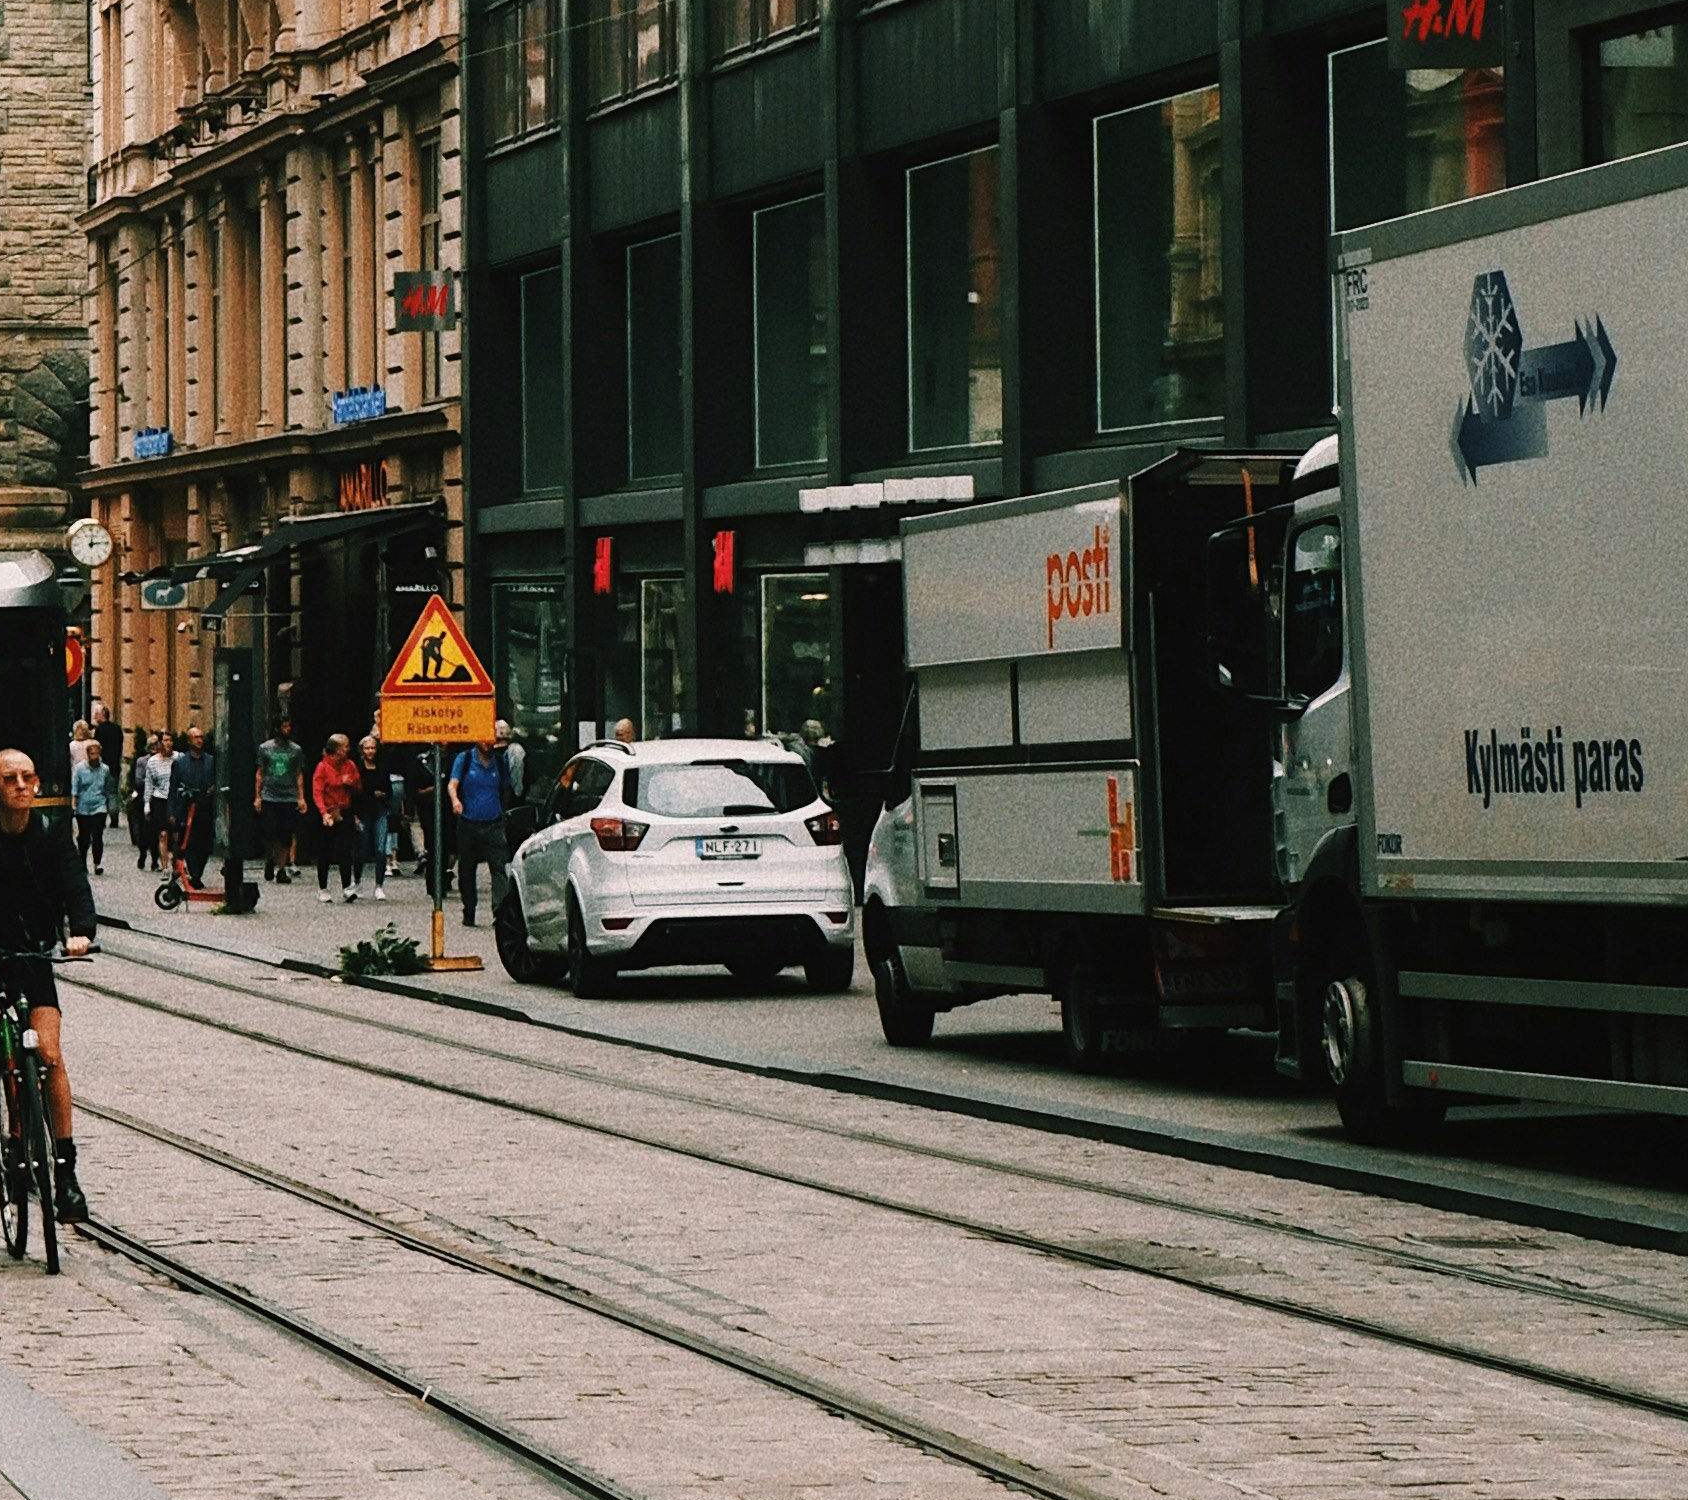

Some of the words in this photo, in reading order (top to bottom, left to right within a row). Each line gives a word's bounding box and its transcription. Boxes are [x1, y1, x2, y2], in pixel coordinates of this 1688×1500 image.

[1344, 268, 1368, 296] FRC
[1046, 524, 1110, 649] posti
[1464, 725, 1566, 809] Kylmästi
[1573, 738, 1644, 809] paras
